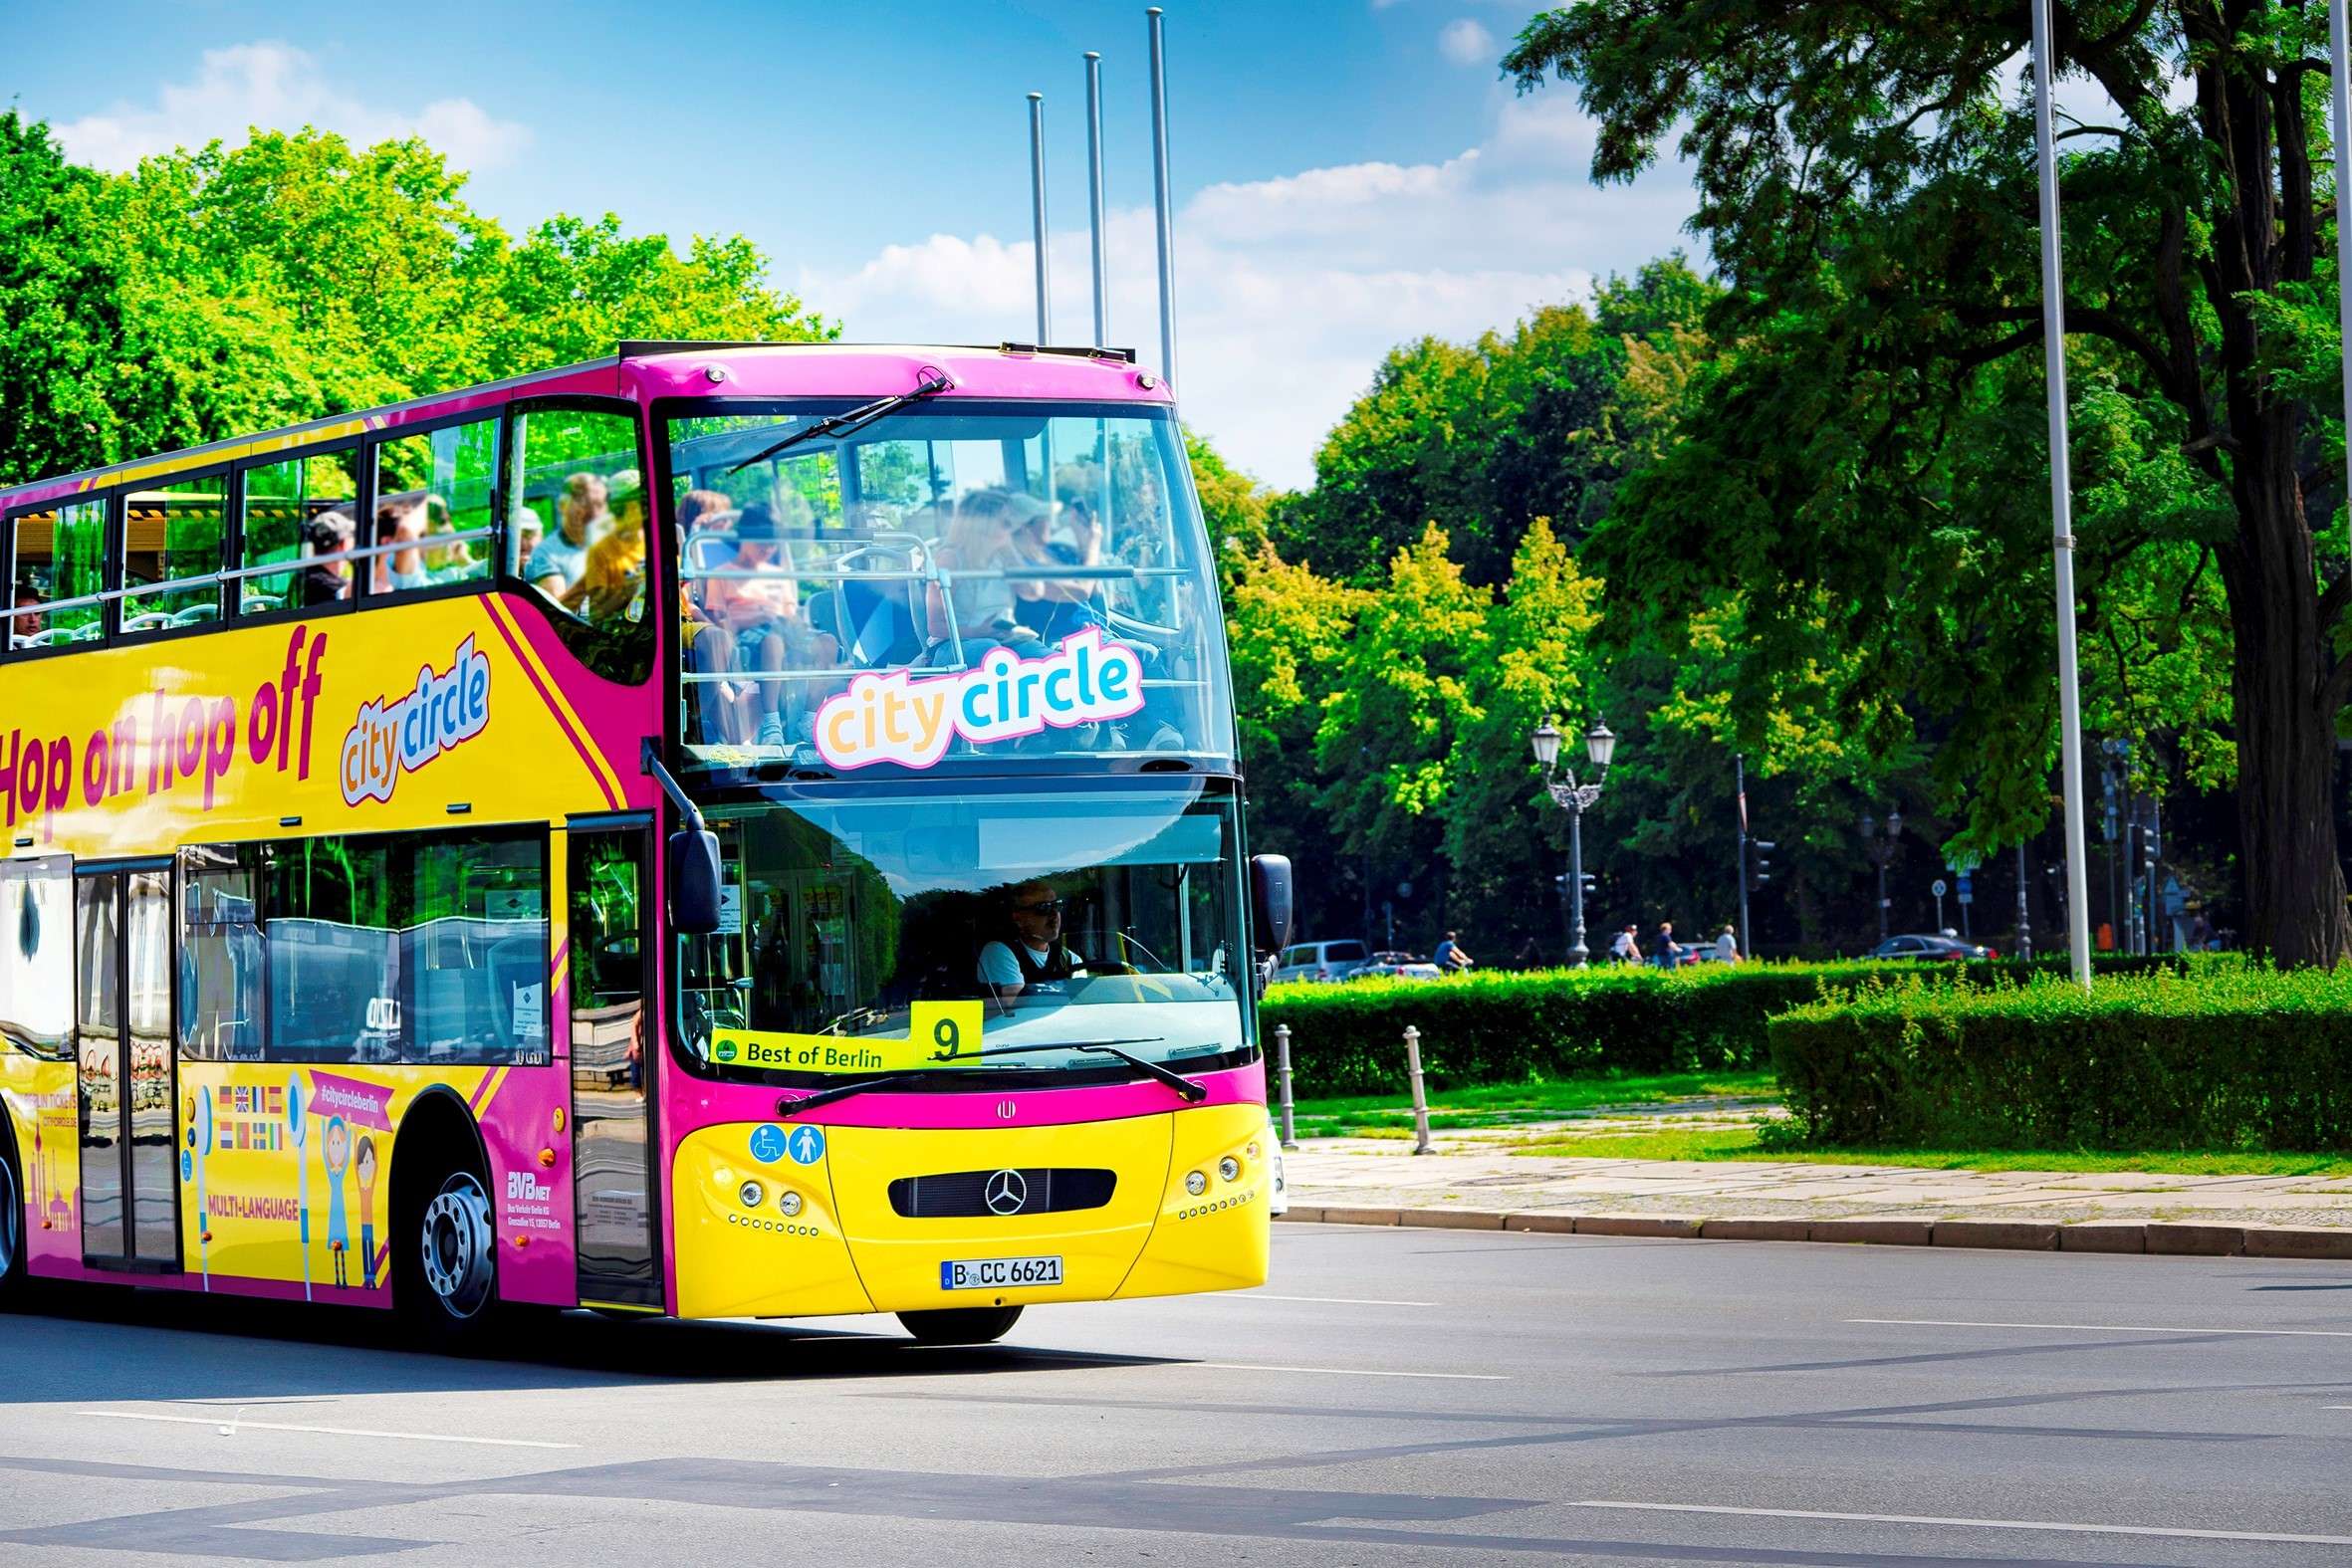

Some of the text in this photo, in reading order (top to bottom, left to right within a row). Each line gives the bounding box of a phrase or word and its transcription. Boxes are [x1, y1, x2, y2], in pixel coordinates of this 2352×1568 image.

[827, 646, 1128, 754] city circle
[0, 624, 327, 844] Hop on hop off
[346, 657, 485, 792] city circle
[747, 1042, 882, 1068] Best of Berlin
[933, 1018, 960, 1062] 9
[322, 1084, 378, 1113] #citycircleberlin
[207, 1194, 299, 1221] MULTI-LANGUAGE
[954, 1259, 1060, 1284] B CC 6621
